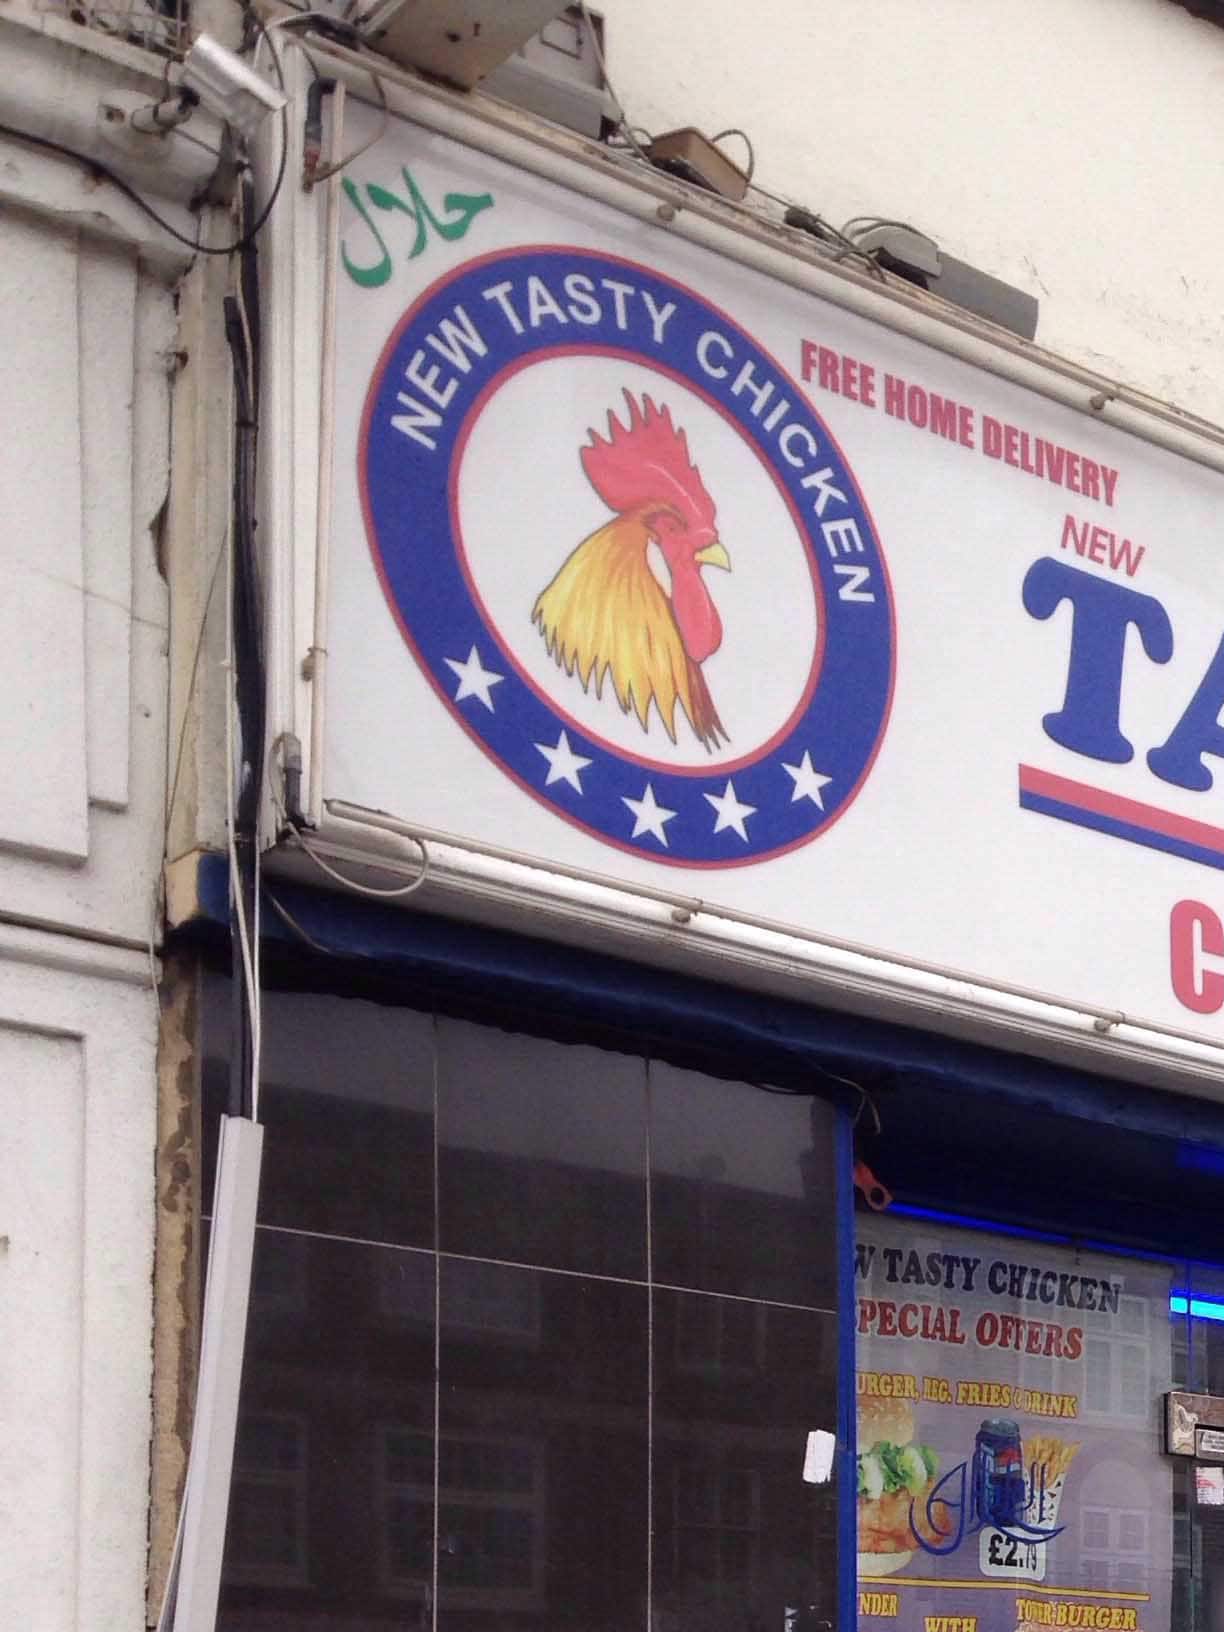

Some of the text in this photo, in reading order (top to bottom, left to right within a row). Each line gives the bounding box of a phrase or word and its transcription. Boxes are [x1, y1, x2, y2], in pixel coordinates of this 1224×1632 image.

[391, 274, 875, 604] NEW TASTY CHICKEN
[801, 338, 1120, 508] FREE HOME DELIVERY
[1061, 514, 1145, 578] NEW
[883, 1247, 982, 1291] TASTY
[987, 1261, 1122, 1314] CHICKEN
[857, 1299, 966, 1345] PECIAL
[857, 1371, 920, 1403] URGER,
[956, 1381, 1012, 1408] FRIES
[858, 1592, 898, 1618] NDER
[1055, 1602, 1138, 1631] BURGER
